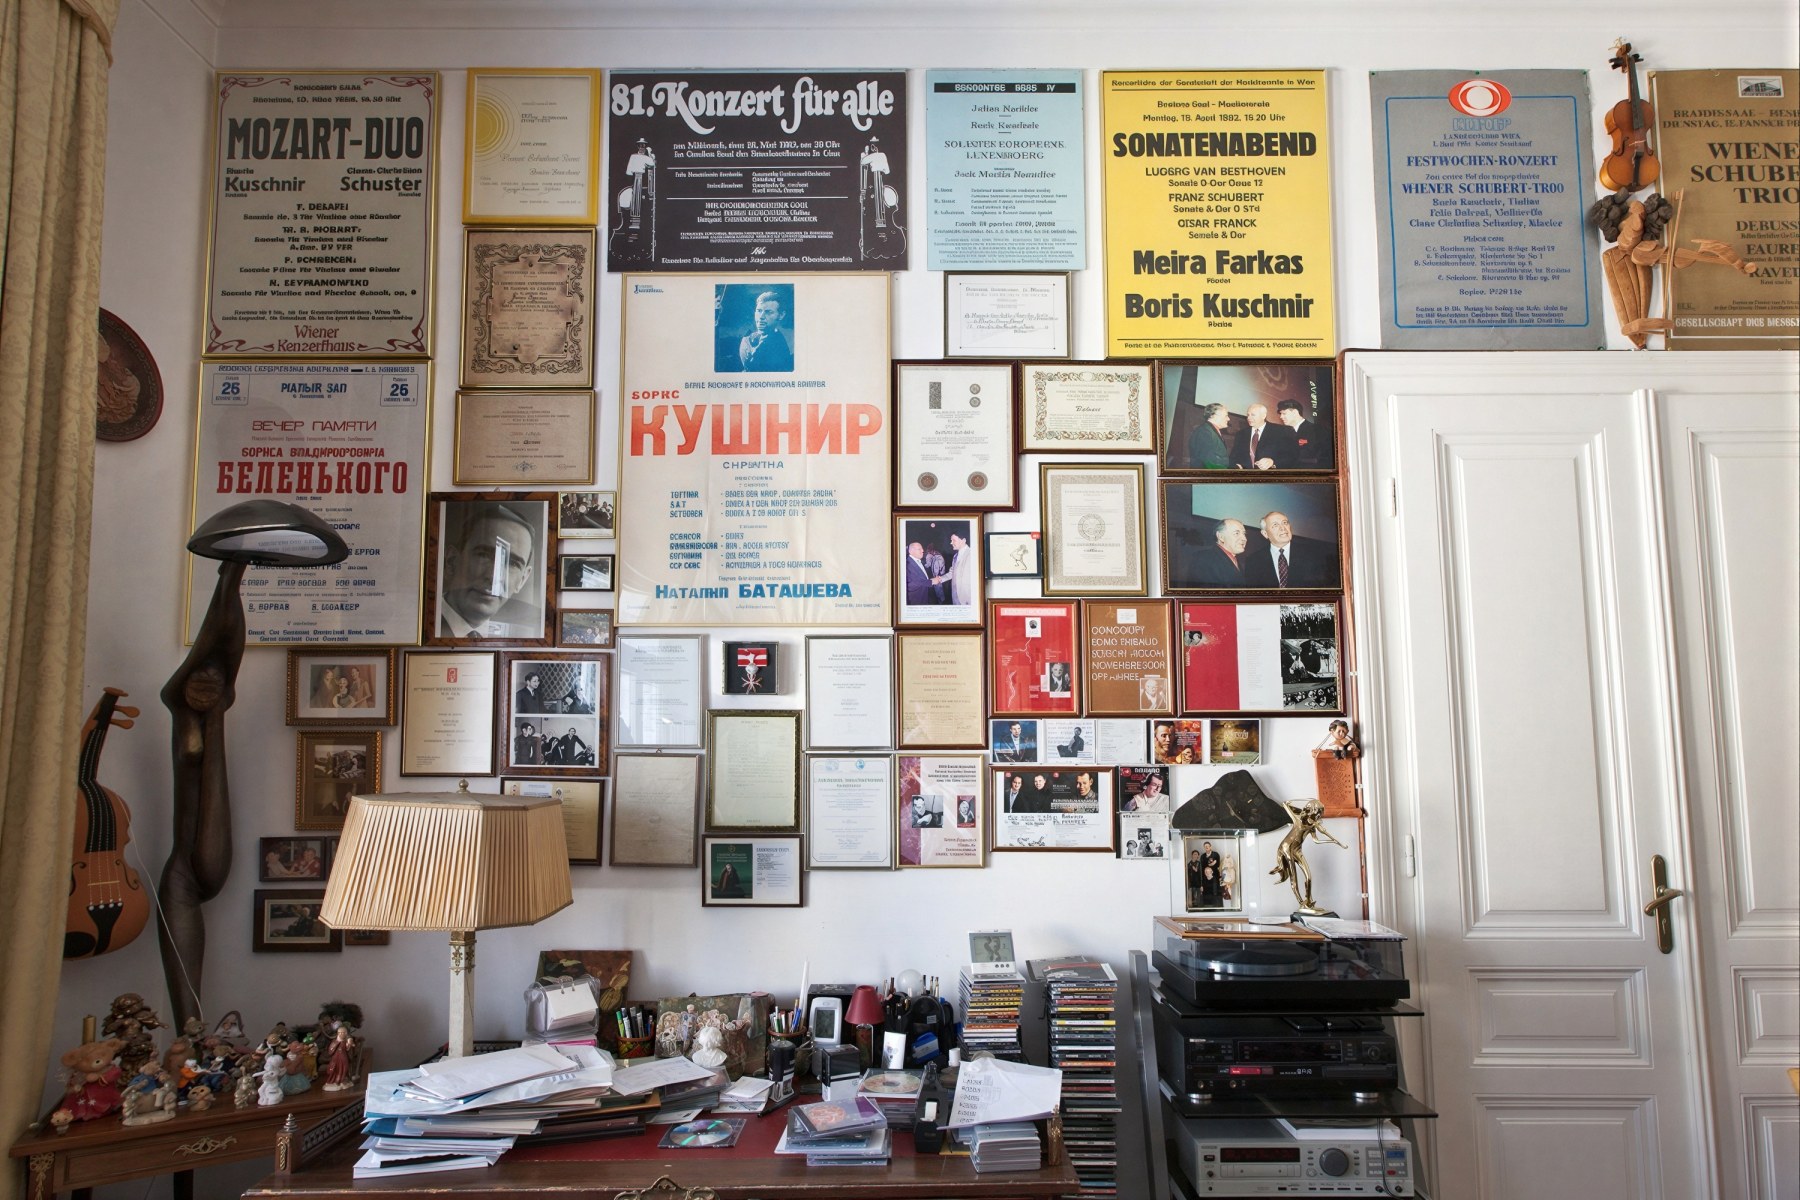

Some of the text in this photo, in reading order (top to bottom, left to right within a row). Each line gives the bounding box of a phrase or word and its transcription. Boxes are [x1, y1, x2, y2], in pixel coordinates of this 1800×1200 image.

[611, 84, 654, 117] 81.
[652, 81, 785, 135] Konzert
[781, 76, 840, 134] für
[842, 81, 895, 131] alle
[227, 117, 424, 160] MOZART-DUO
[1113, 132, 1317, 157] SONATENABEND
[1194, 167, 1216, 176] VAN
[225, 177, 306, 191] Kuschnir
[340, 176, 422, 191] Schuster
[1208, 193, 1264, 202] SCHUBERT
[1214, 219, 1256, 228] FRANCK
[1736, 221, 1799, 231] DEBUSS
[1134, 250, 1304, 274] Meira Farkas
[1125, 294, 1314, 318] Boris Kuschnir
[252, 421, 304, 431] ВЕЧЕР
[631, 404, 882, 456] КУШНИР
[216, 462, 408, 494] БЕЛЕНЬКОГО
